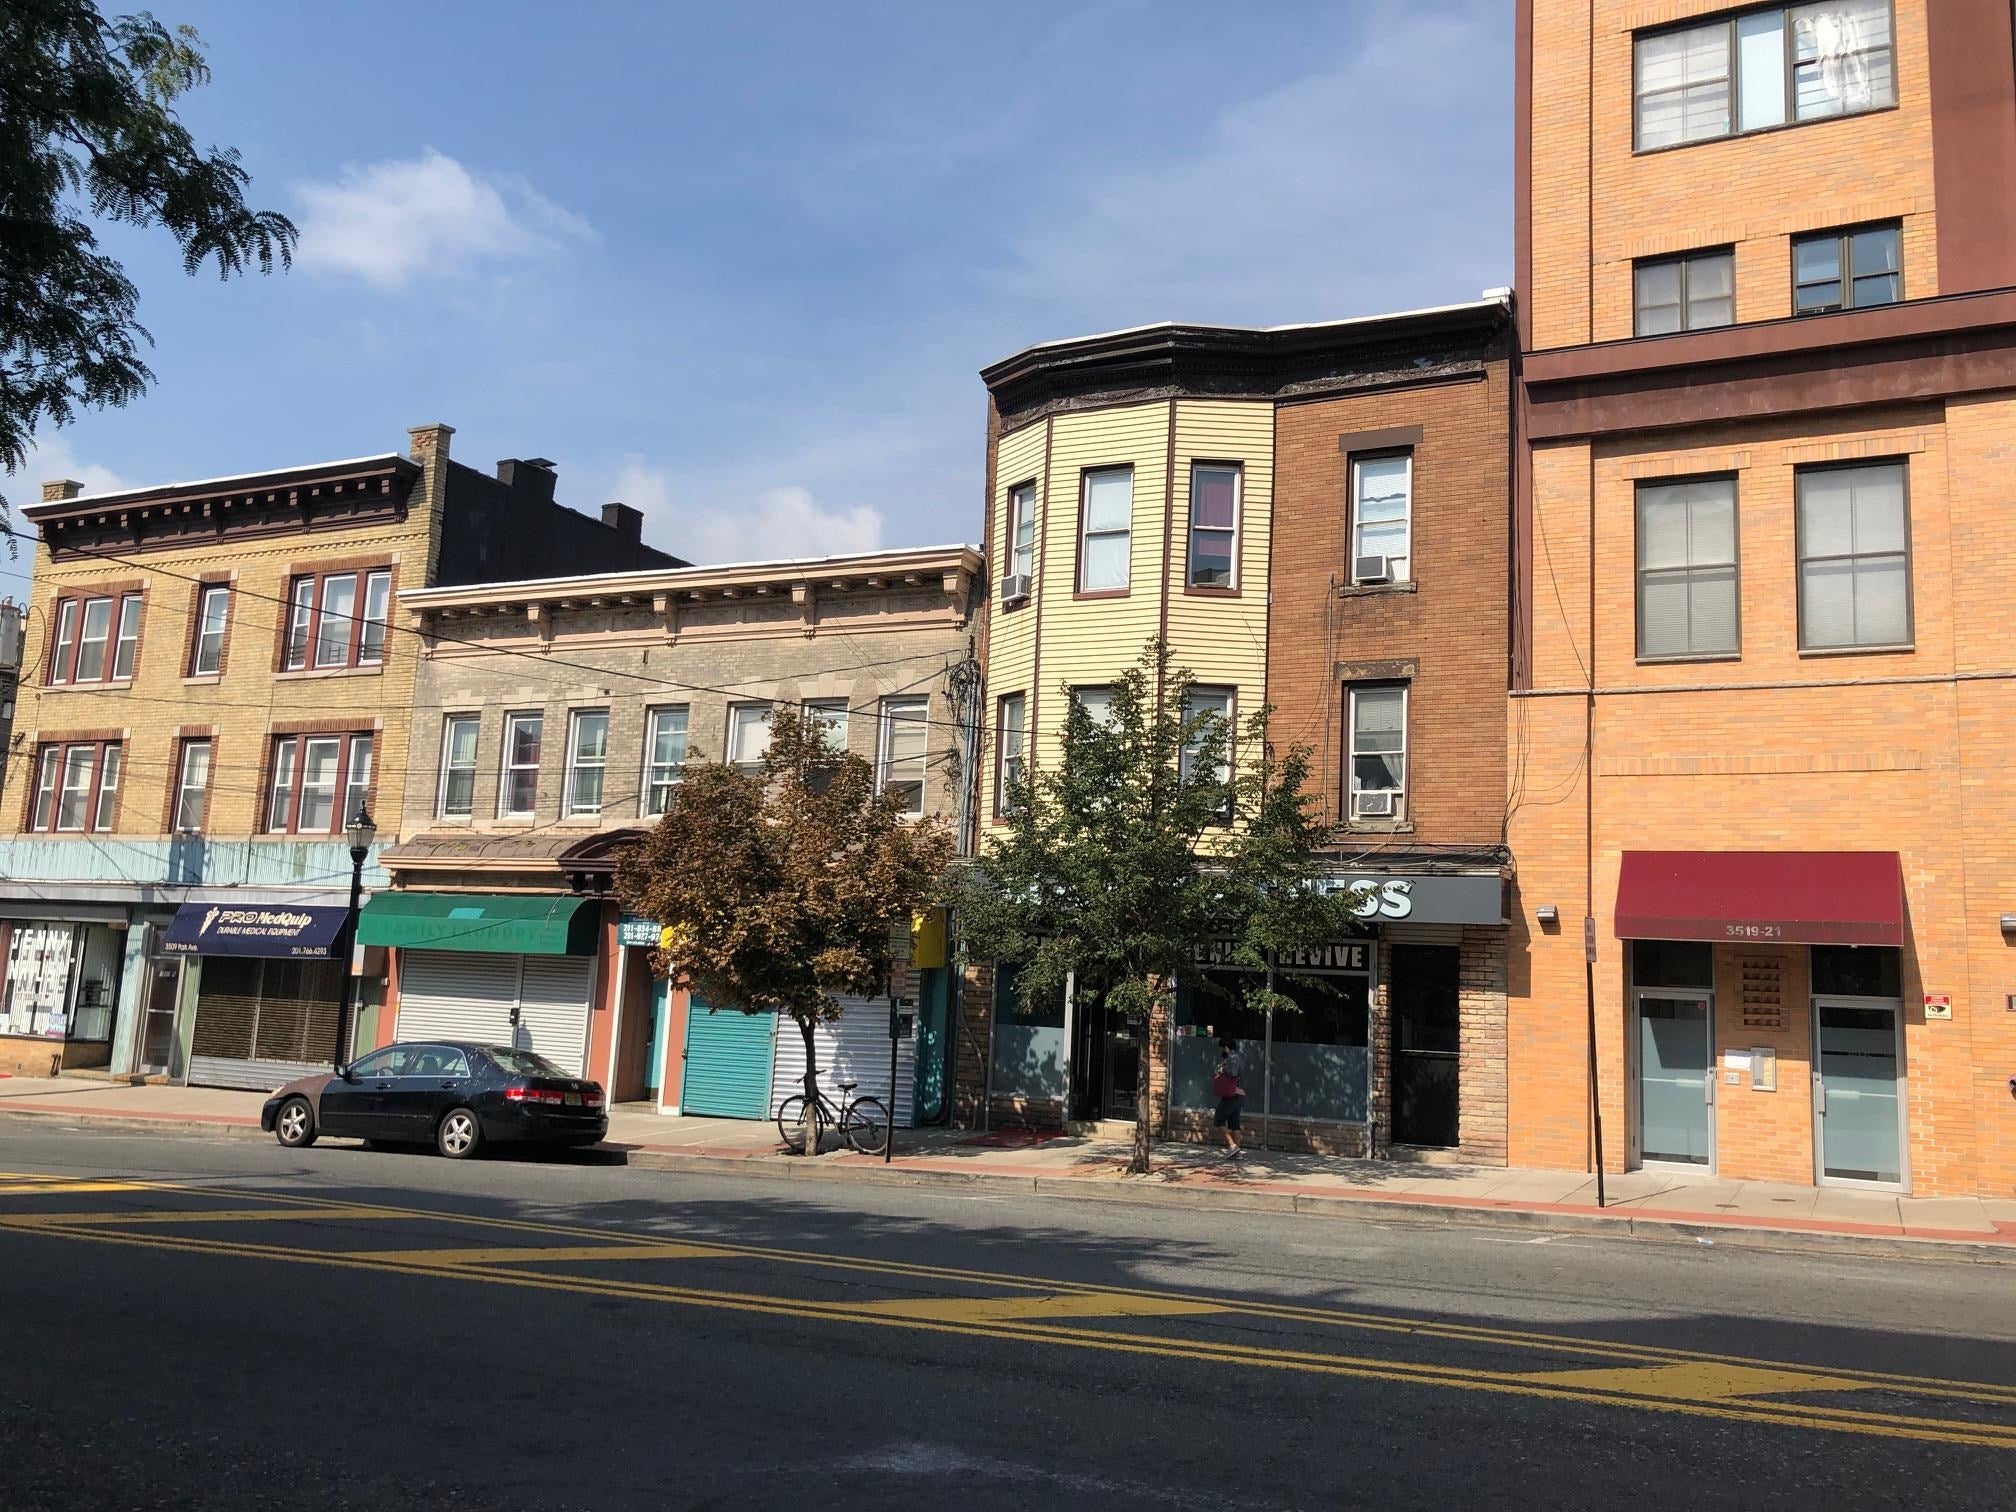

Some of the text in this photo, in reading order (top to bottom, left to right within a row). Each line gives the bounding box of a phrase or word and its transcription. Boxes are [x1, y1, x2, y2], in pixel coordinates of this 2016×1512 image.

[257, 911, 313, 929] MedQuip
[241, 927, 267, 936] MEDICAL
[266, 927, 301, 937] EQUIPMENT
[1726, 925, 1781, 937] 3519-21
[12, 928, 70, 951] JENNY
